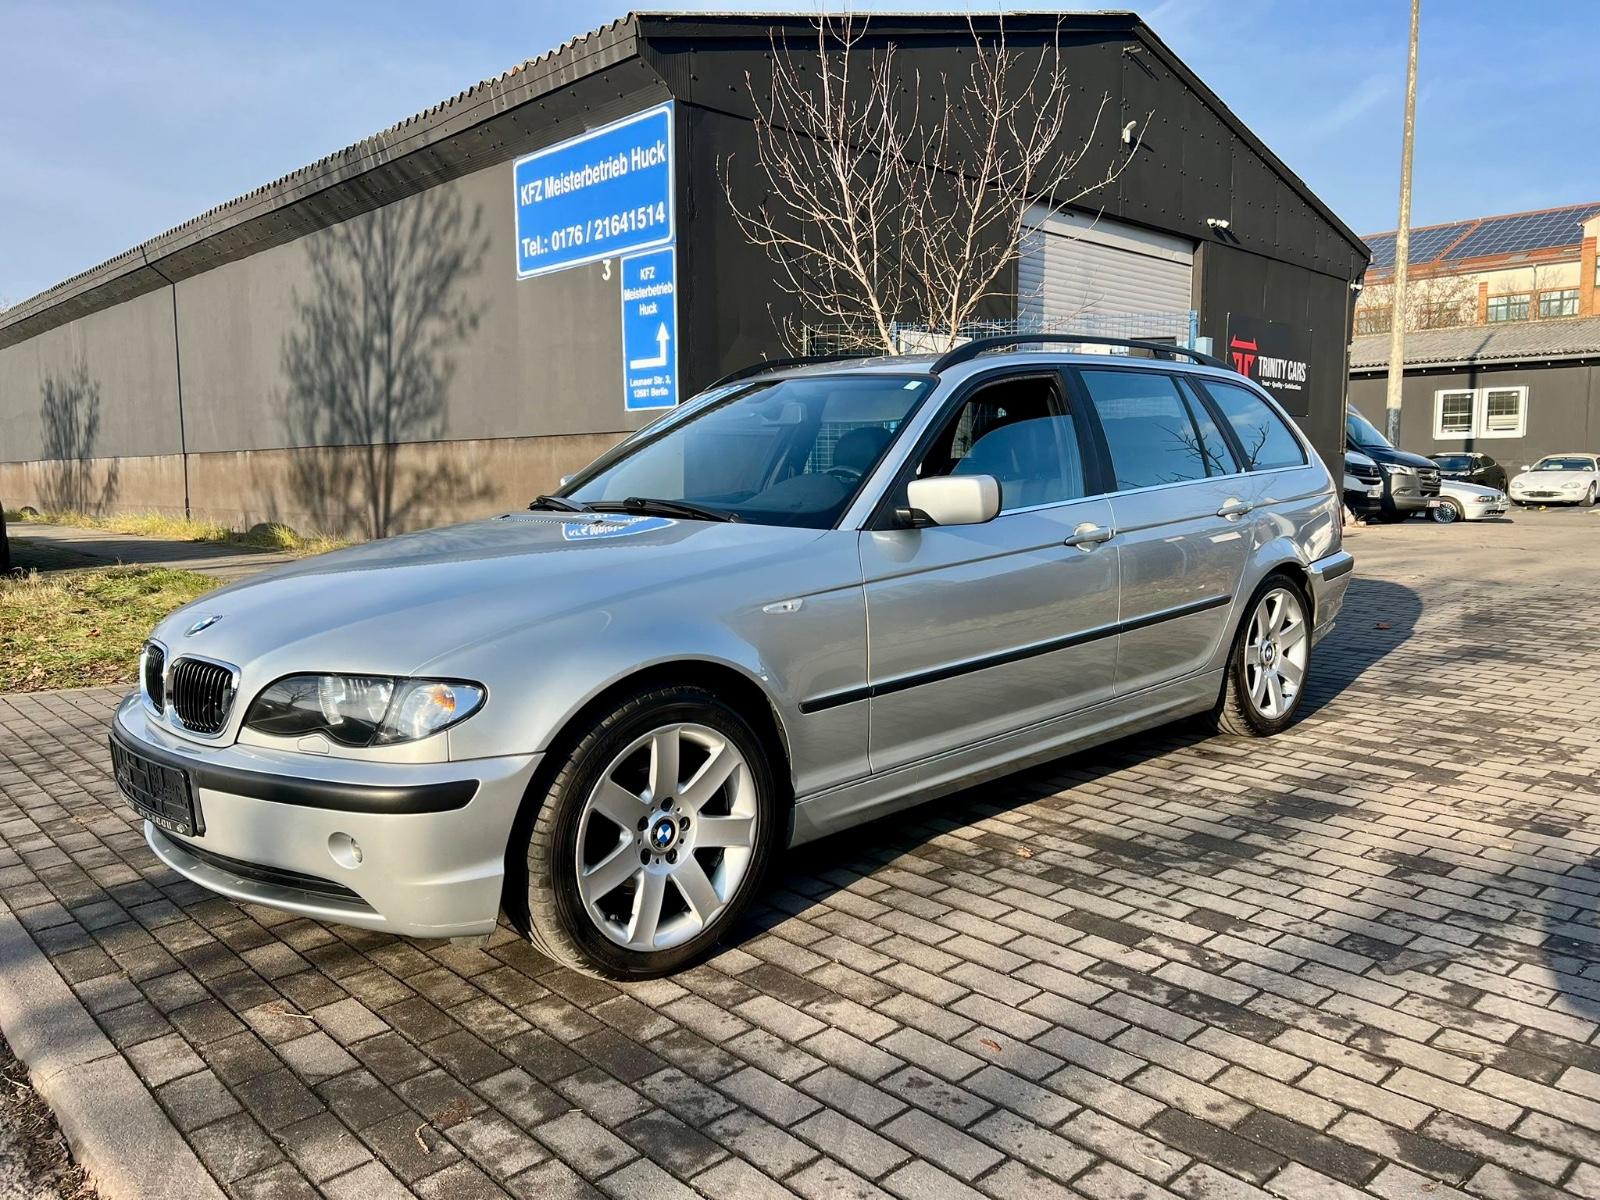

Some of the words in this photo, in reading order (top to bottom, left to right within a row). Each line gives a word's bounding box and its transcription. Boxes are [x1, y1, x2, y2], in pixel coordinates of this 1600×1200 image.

[520, 180, 543, 207] KFZ
[544, 152, 628, 199] Meisterbetrieb
[631, 140, 666, 172] Huck
[522, 237, 548, 258] Tel.:
[551, 224, 583, 251] 0176
[586, 221, 591, 243] /
[594, 201, 665, 240] 21641514
[602, 259, 612, 281] 3
[640, 266, 655, 280] KFZ
[624, 282, 673, 301] Meisterbetrieb
[639, 302, 658, 316] Huck
[1258, 355, 1287, 379] TRINITY
[1287, 360, 1306, 382] CARS
[653, 375, 665, 385] Str.
[650, 386, 669, 397] Berlin
